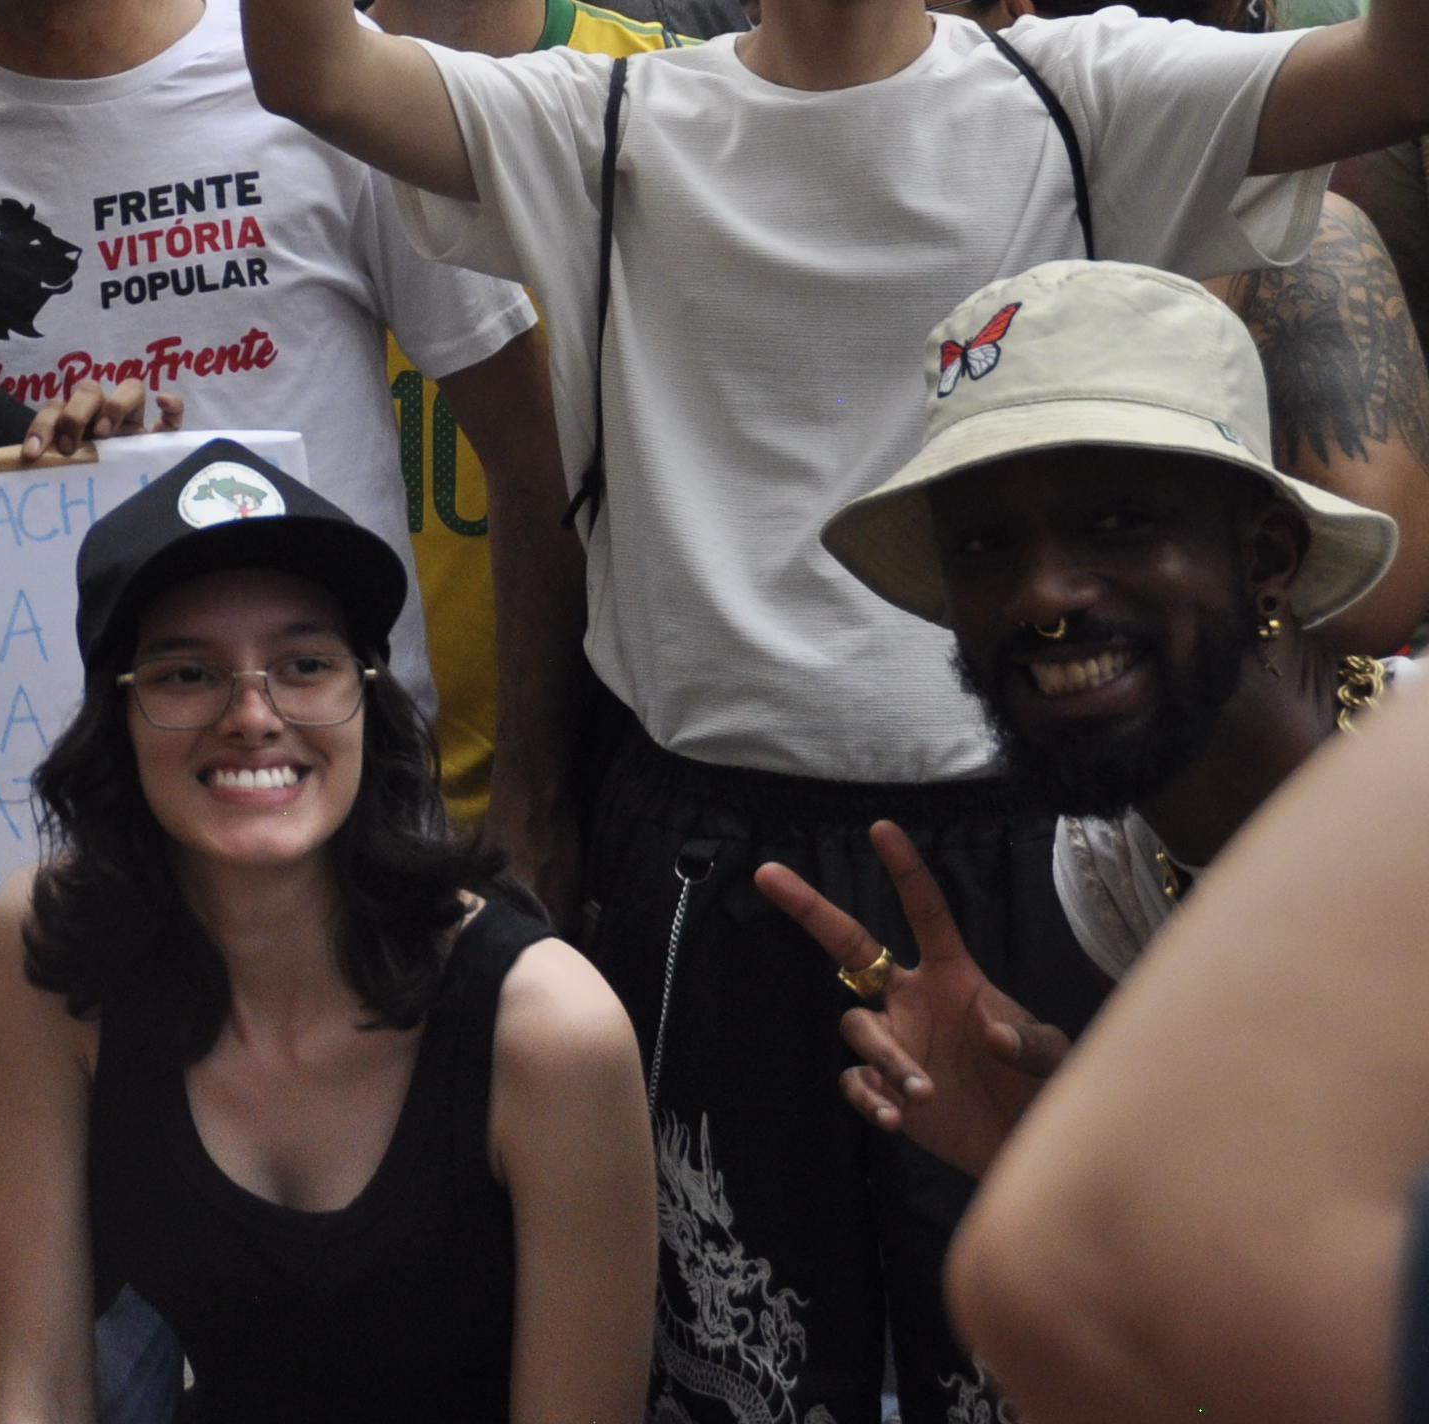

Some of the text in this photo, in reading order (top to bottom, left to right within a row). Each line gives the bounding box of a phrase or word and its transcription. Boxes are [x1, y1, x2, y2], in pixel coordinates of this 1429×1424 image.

[93, 171, 263, 231] FRENTE
[97, 215, 267, 271] VITÓRIA
[100, 257, 271, 310] POPULAR
